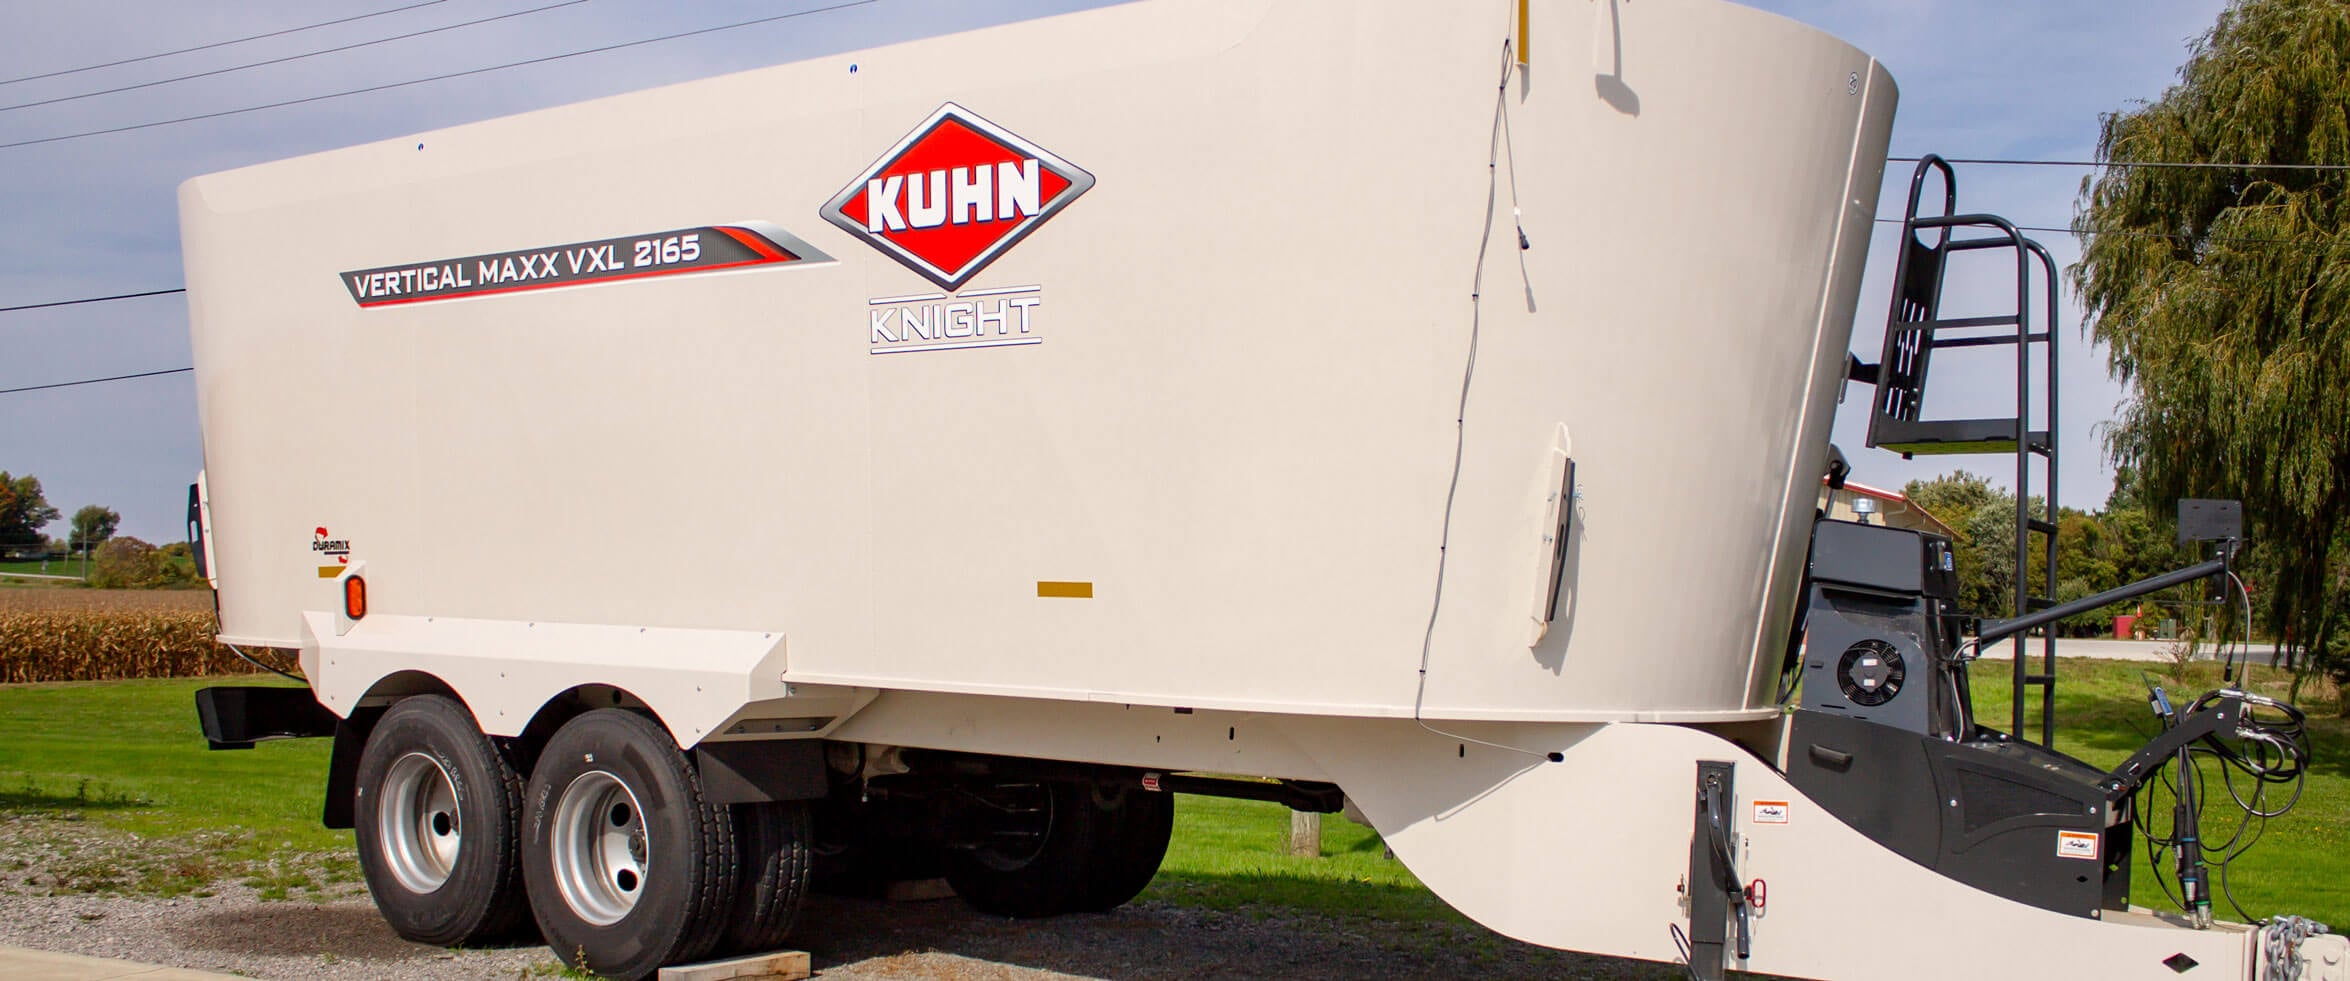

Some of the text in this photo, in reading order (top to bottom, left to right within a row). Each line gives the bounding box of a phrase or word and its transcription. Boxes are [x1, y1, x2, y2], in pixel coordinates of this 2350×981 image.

[867, 158, 1041, 234] KUHN
[354, 233, 701, 298] VERTICAL MAXX VXL 2165
[870, 296, 1041, 343] KNIGHT
